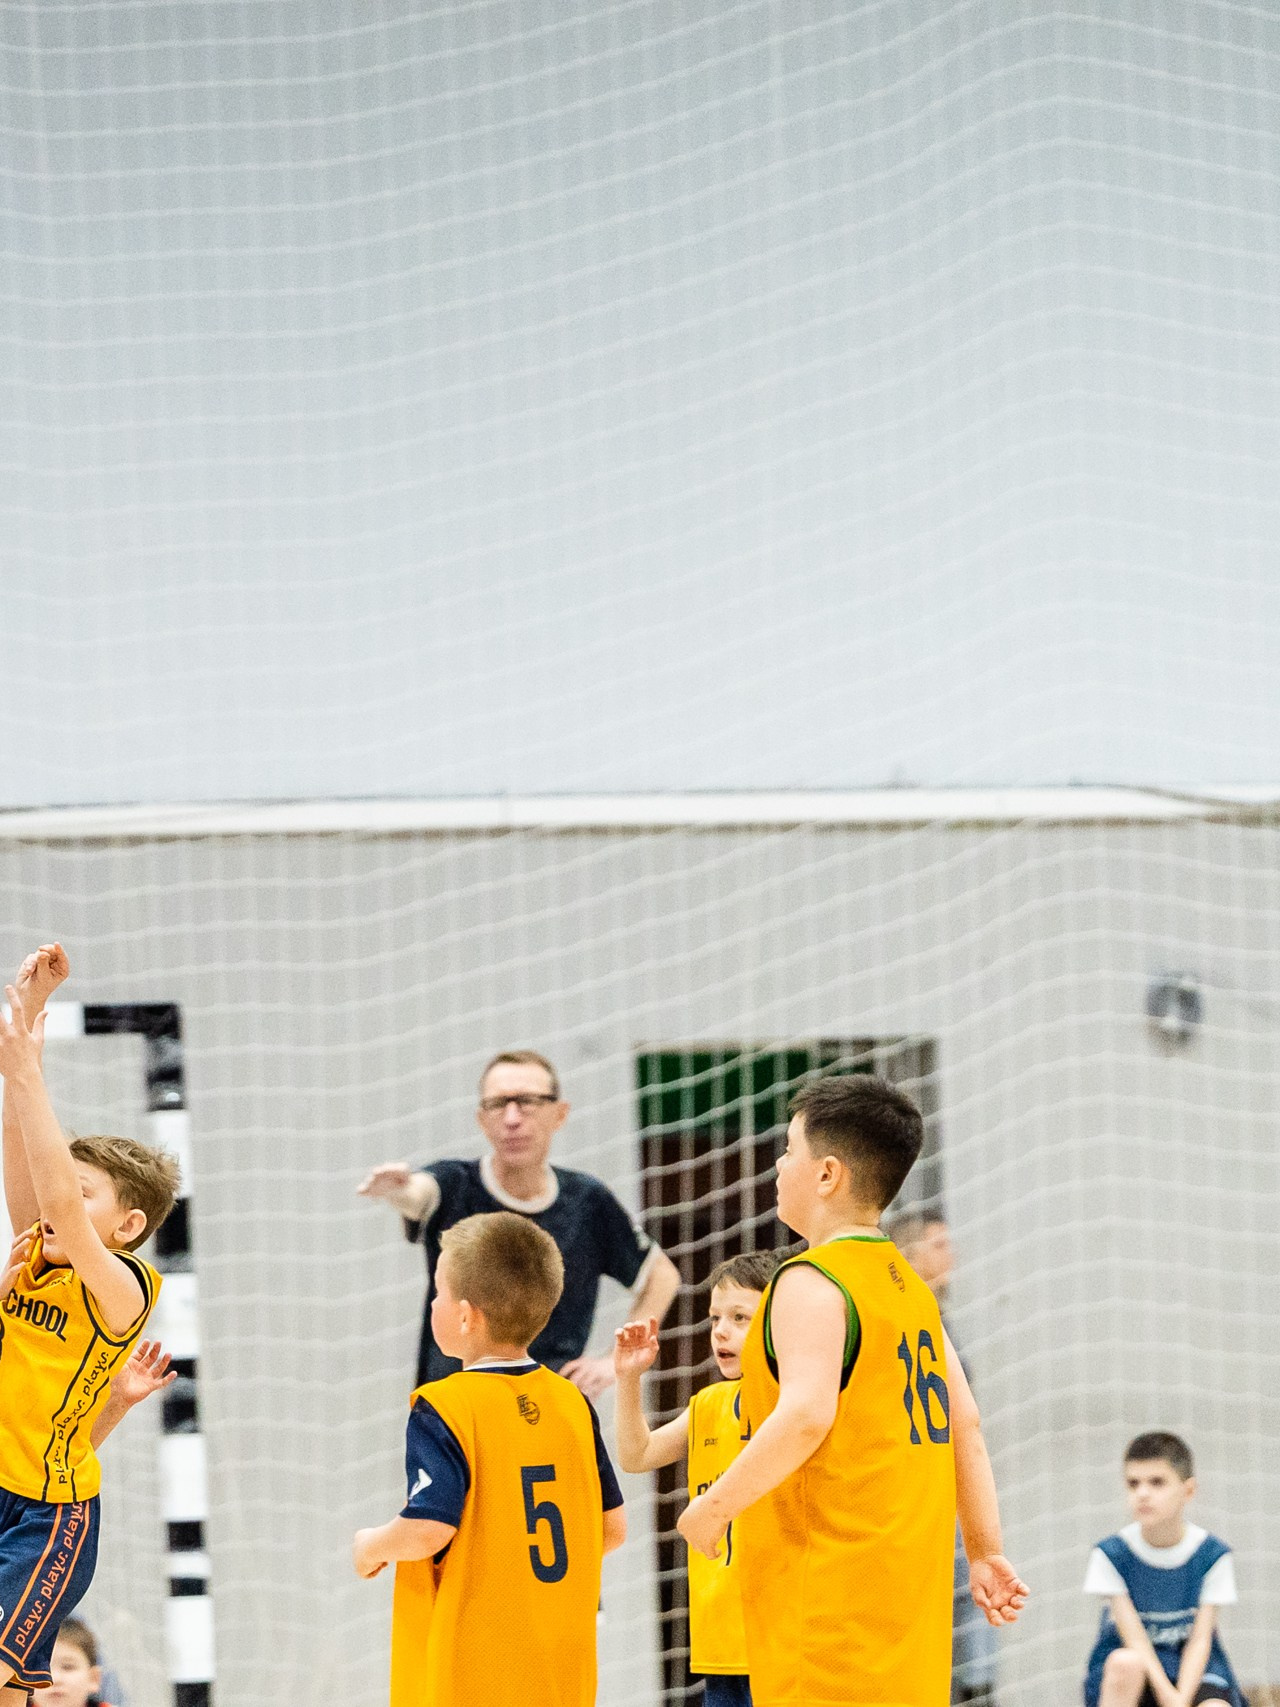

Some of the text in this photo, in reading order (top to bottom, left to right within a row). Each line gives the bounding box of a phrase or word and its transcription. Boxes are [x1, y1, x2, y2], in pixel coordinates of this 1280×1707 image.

[5, 1287, 69, 1343] CHOOL
[897, 1328, 950, 1445] 16
[520, 1463, 569, 1584] 5
